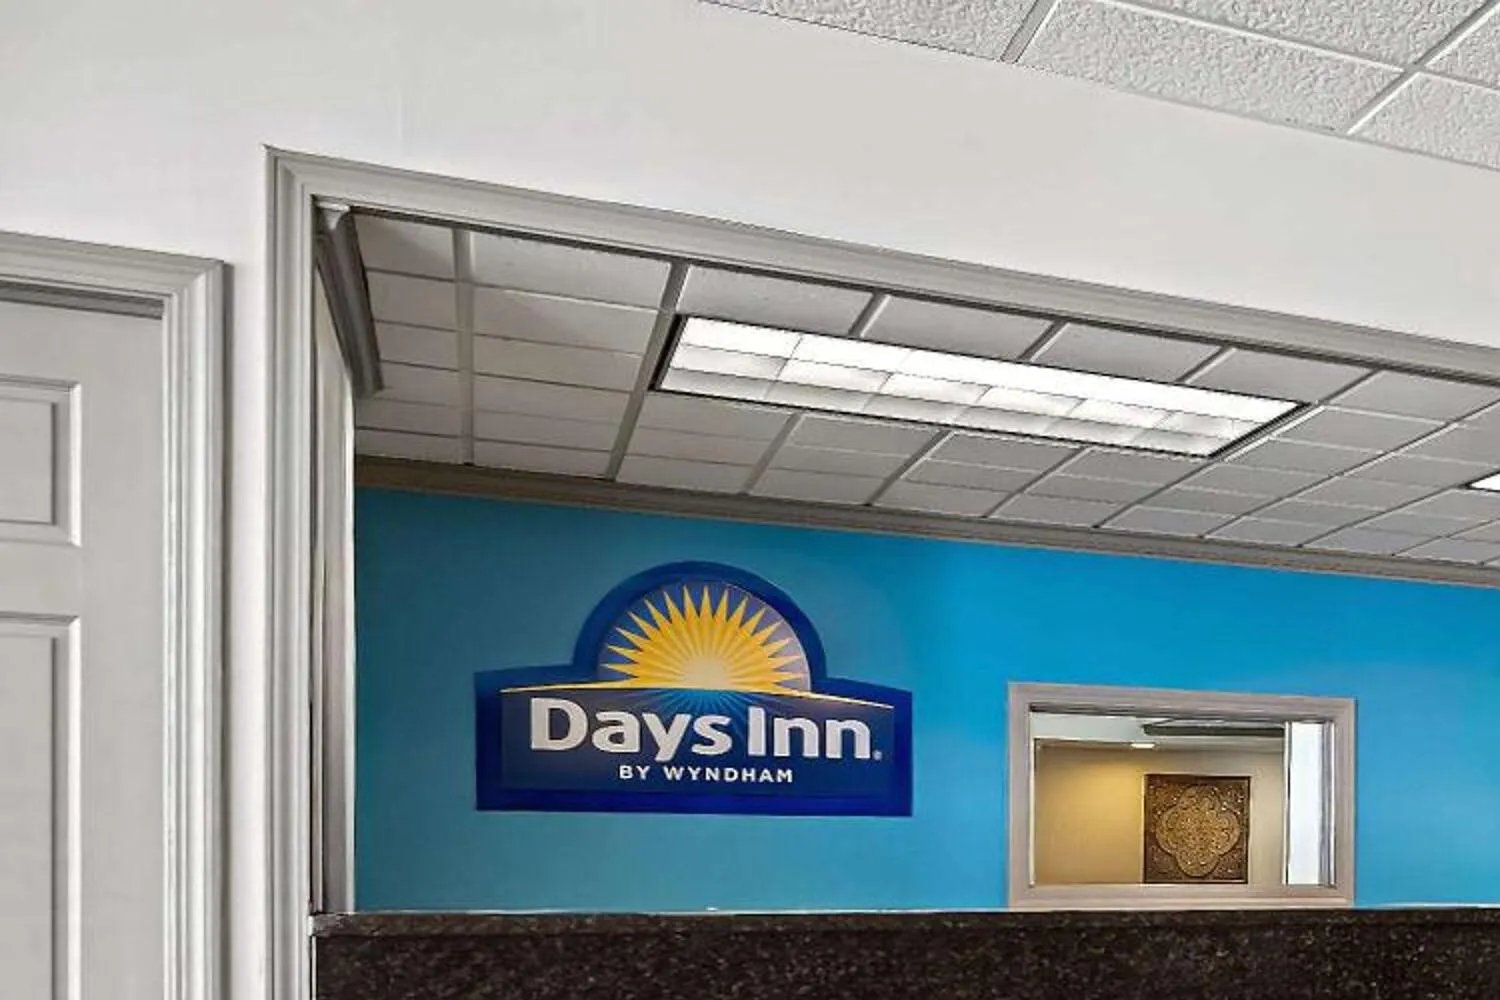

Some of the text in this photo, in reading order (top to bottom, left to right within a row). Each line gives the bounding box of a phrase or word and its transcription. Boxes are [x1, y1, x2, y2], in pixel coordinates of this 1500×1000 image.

[530, 697, 733, 763] Days
[618, 765, 794, 784] BY WYNDHAM
